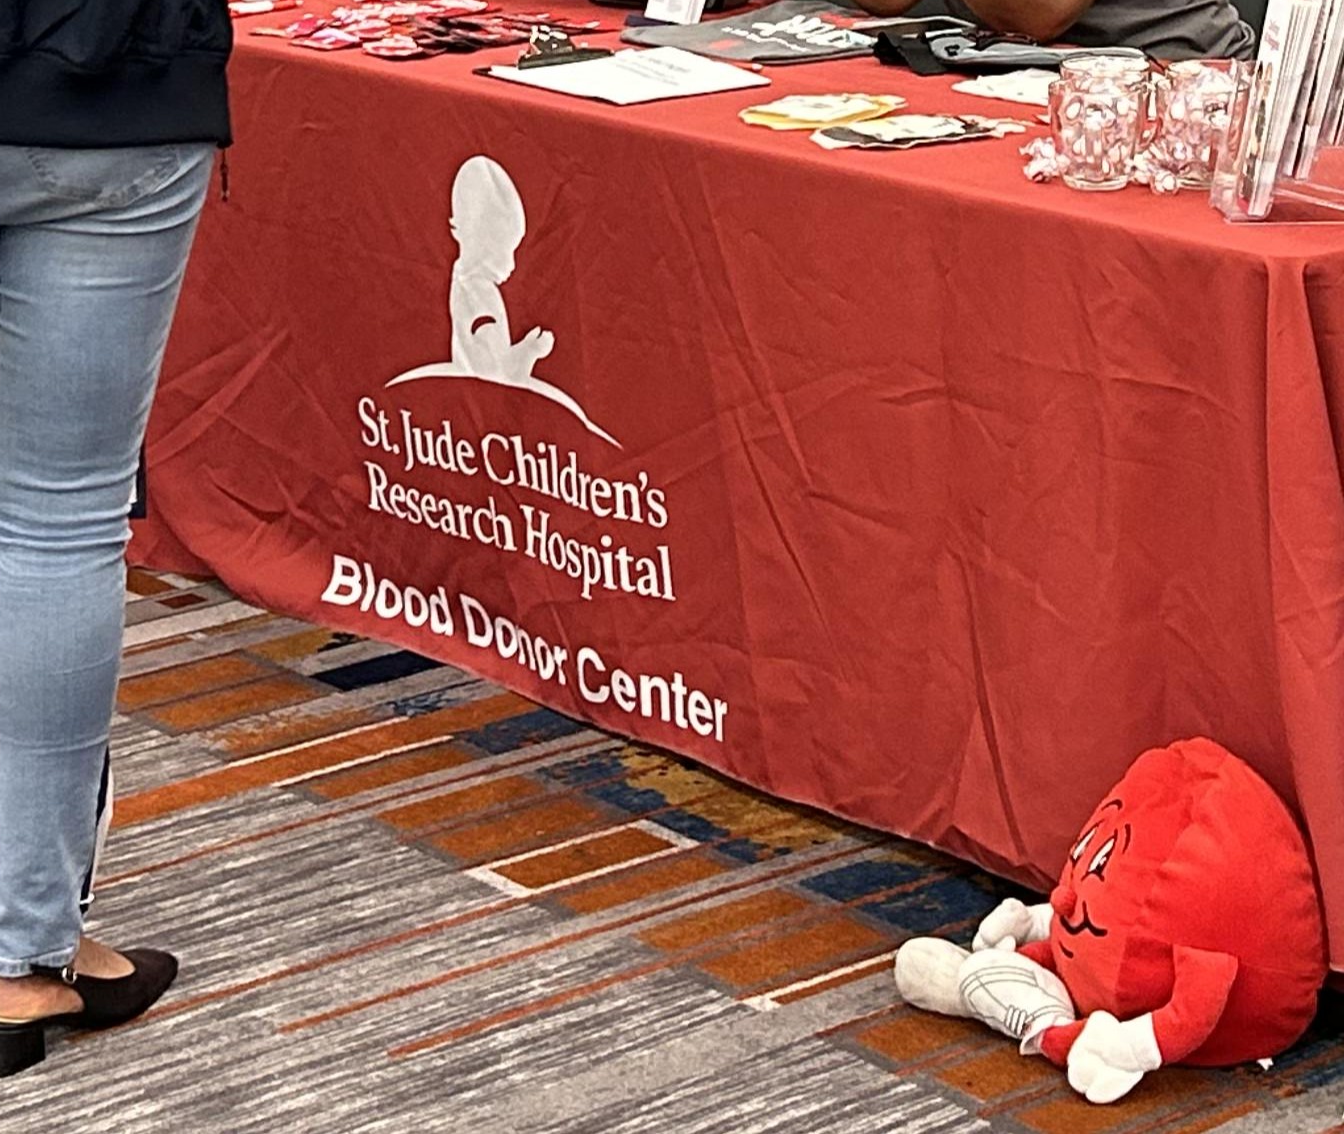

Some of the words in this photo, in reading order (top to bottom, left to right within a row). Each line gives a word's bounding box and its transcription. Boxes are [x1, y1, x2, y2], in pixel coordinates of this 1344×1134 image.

[358, 396, 400, 454] St.
[399, 408, 478, 476] Jude
[480, 432, 669, 529] Children's
[363, 460, 518, 552] Research
[519, 503, 677, 602] Hospital
[320, 554, 455, 637] Blood
[459, 592, 568, 686] Donor
[576, 646, 729, 743] Center
